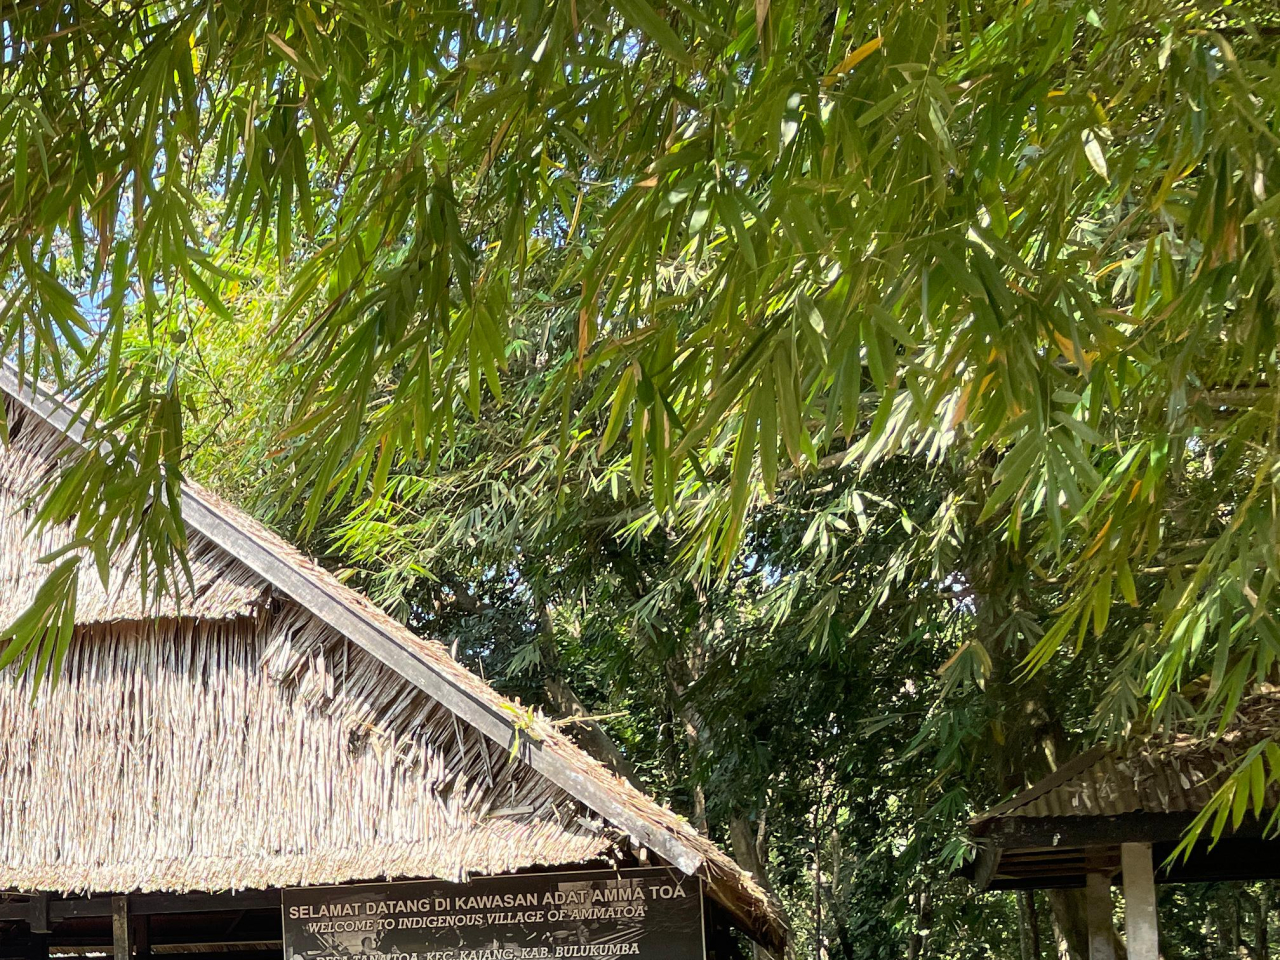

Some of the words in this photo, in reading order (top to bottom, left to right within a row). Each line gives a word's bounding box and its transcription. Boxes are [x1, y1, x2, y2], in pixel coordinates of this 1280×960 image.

[289, 903, 361, 919] SELAMAT
[366, 898, 430, 915] DATANG
[434, 898, 450, 911] DI
[455, 893, 538, 910] KAWASAN
[542, 889, 588, 906] ADAT
[591, 887, 645, 903] AMMA
[649, 884, 686, 899] TOA
[308, 919, 374, 933] WELCOME
[378, 918, 396, 930] TO
[398, 914, 483, 929] INDIGENOUS
[487, 910, 544, 925] VILLAGE
[547, 909, 567, 921] OF
[570, 905, 646, 920] AMMATOA
[521, 947, 552, 960] KAB.
[555, 942, 640, 958] BULUKUMBA
